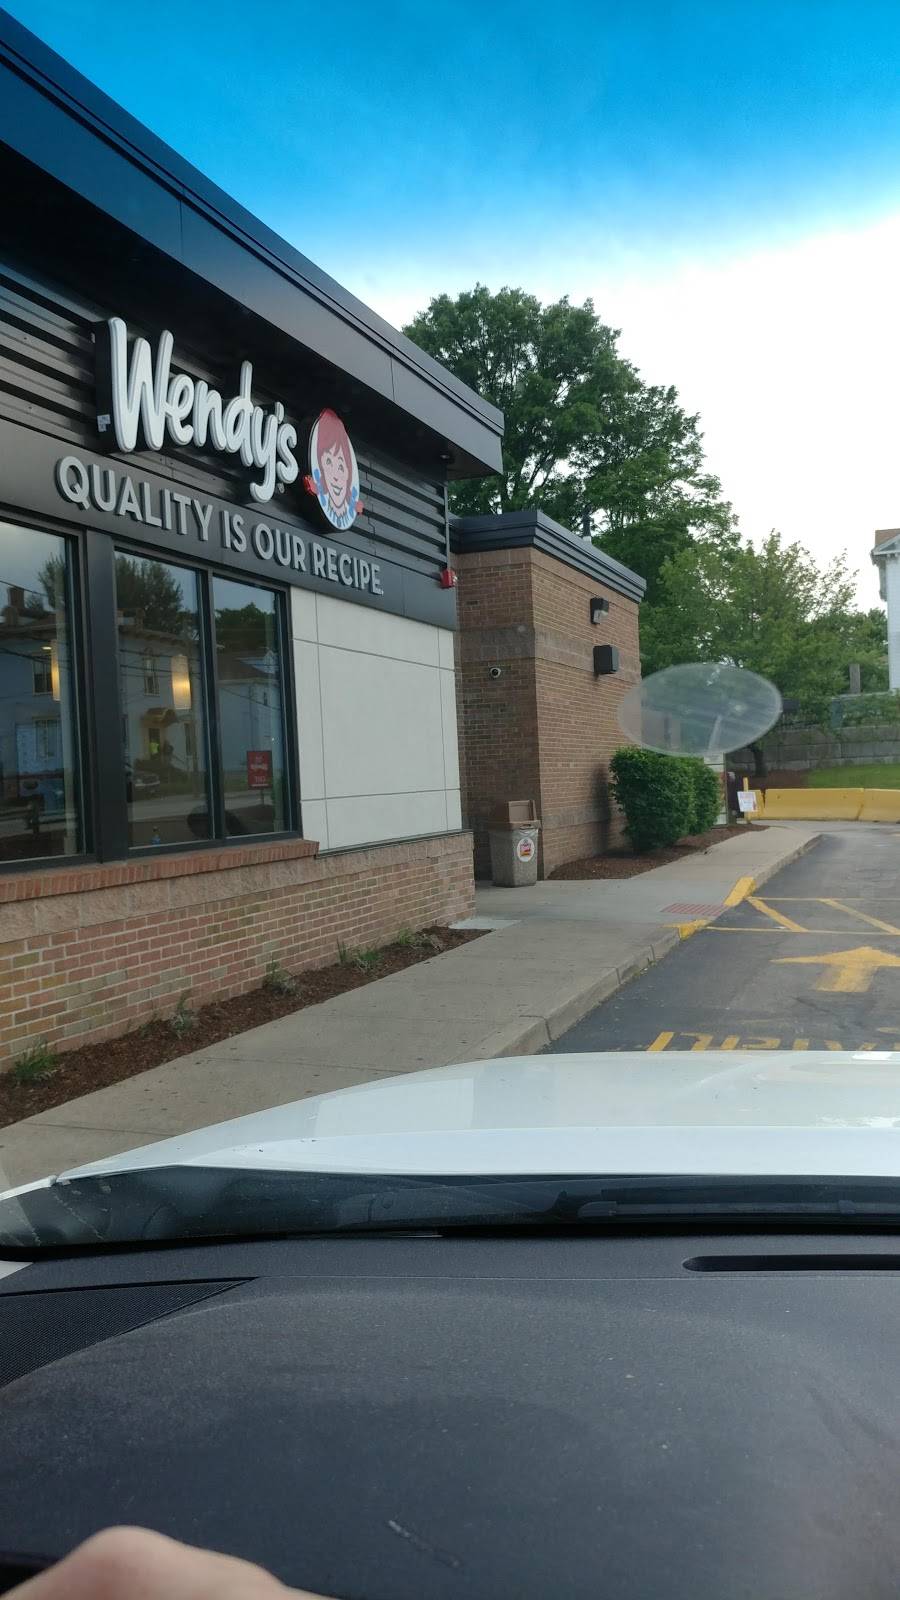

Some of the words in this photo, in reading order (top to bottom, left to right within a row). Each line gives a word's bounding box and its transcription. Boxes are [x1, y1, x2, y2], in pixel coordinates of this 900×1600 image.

[108, 316, 299, 503] Wendy's
[55, 455, 213, 542] QUALITY
[221, 510, 247, 553] IS
[252, 523, 307, 572] OUR
